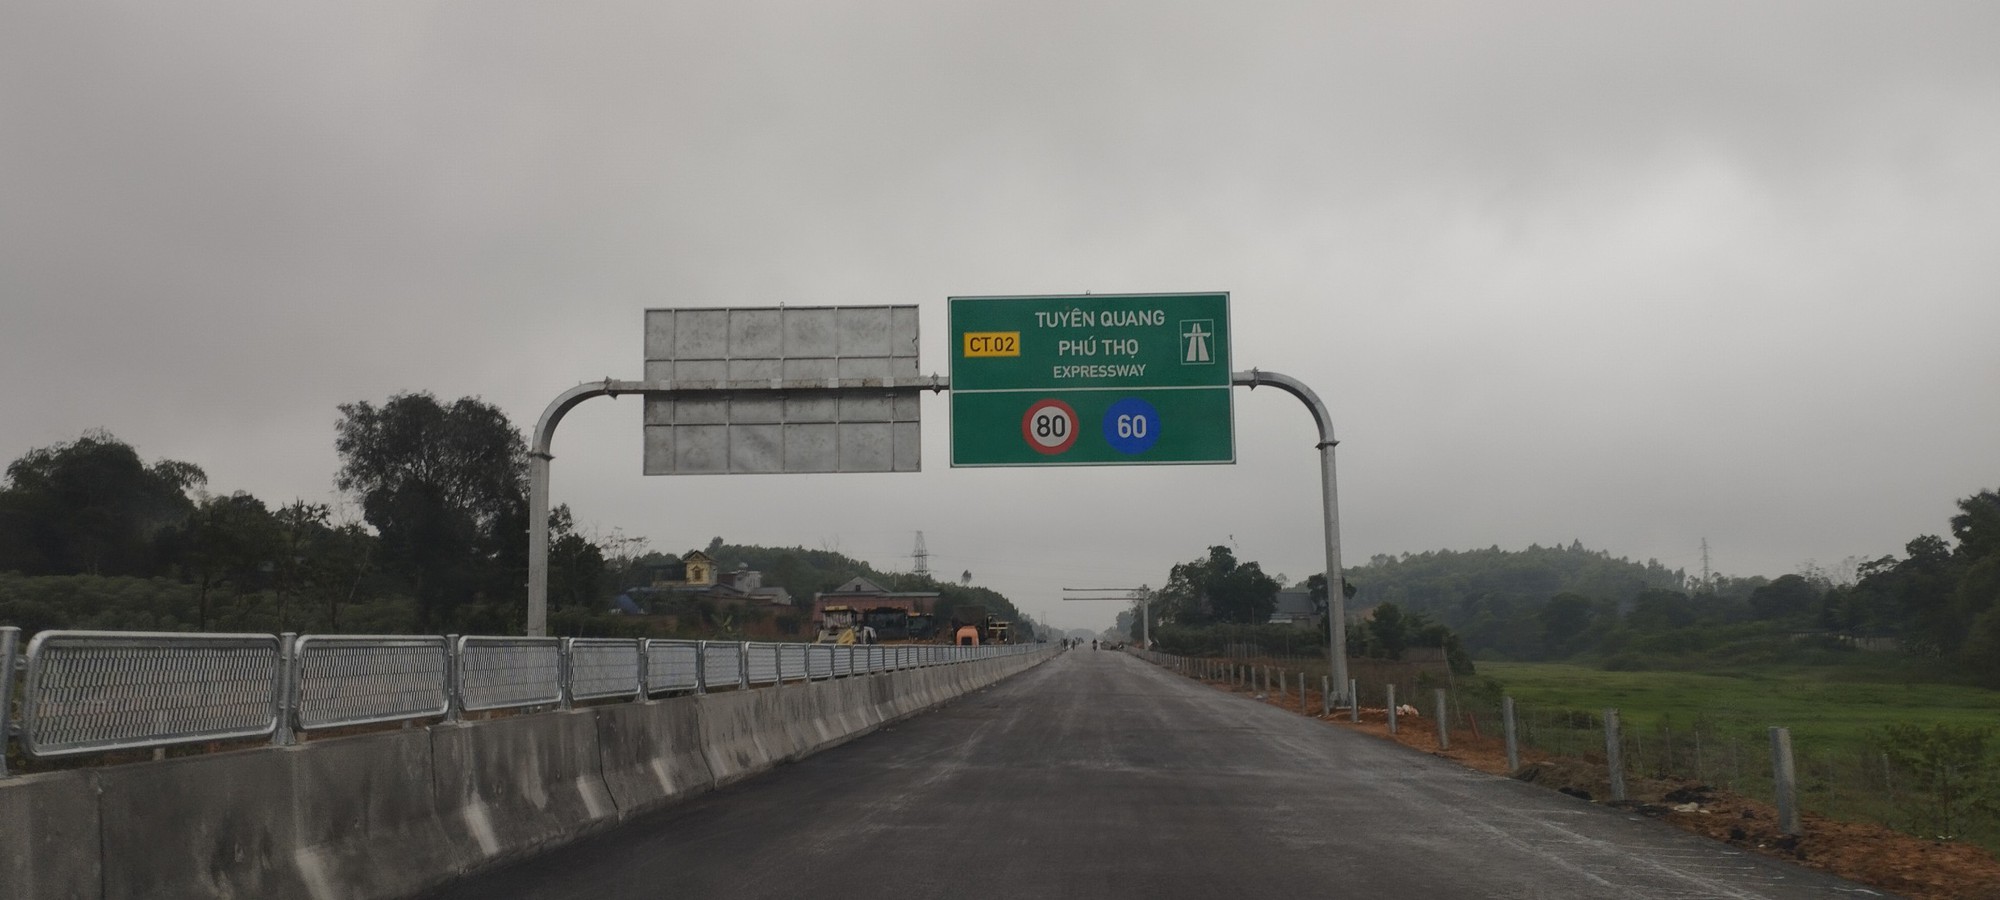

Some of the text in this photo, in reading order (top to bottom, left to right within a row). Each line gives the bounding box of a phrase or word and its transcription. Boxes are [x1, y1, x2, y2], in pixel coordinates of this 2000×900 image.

[1035, 308, 1165, 328] TUYÊN QUANG
[969, 337, 1015, 353] CT.02
[1058, 335, 1139, 358] PHÚ THỌ
[1053, 364, 1146, 379] EXPRESSWAY
[1036, 414, 1066, 438] 80
[1117, 415, 1147, 438] 60
